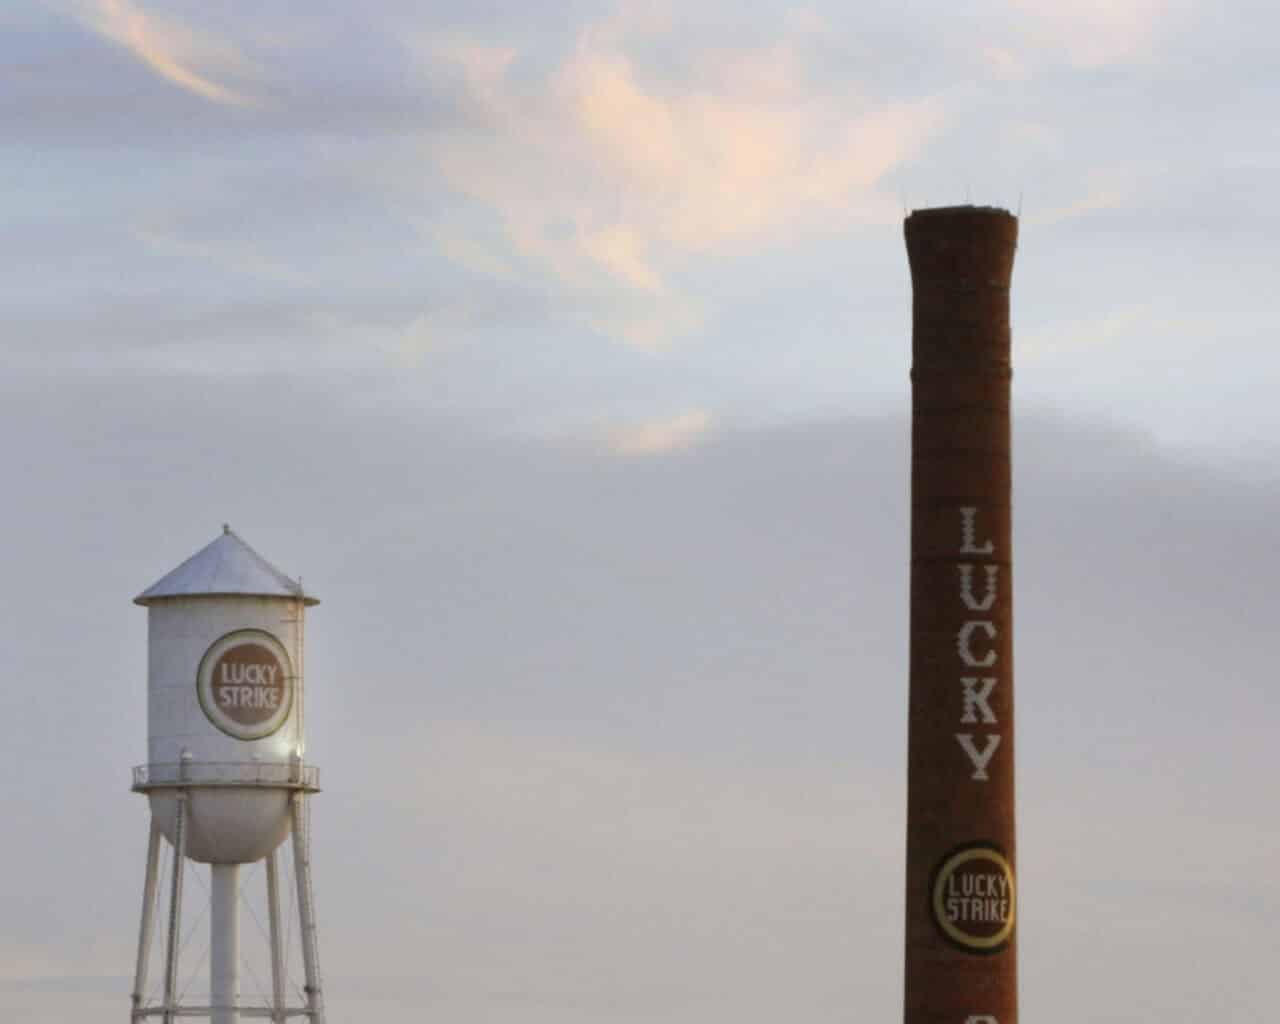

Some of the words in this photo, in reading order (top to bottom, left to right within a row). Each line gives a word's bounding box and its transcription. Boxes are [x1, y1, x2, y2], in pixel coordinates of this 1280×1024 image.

[955, 506, 1002, 781] LUCKY
[221, 663, 280, 685] LUCKY
[219, 685, 281, 709] STRIKE
[947, 873, 1009, 897] LUCKY
[944, 897, 1010, 921] STRIKE
